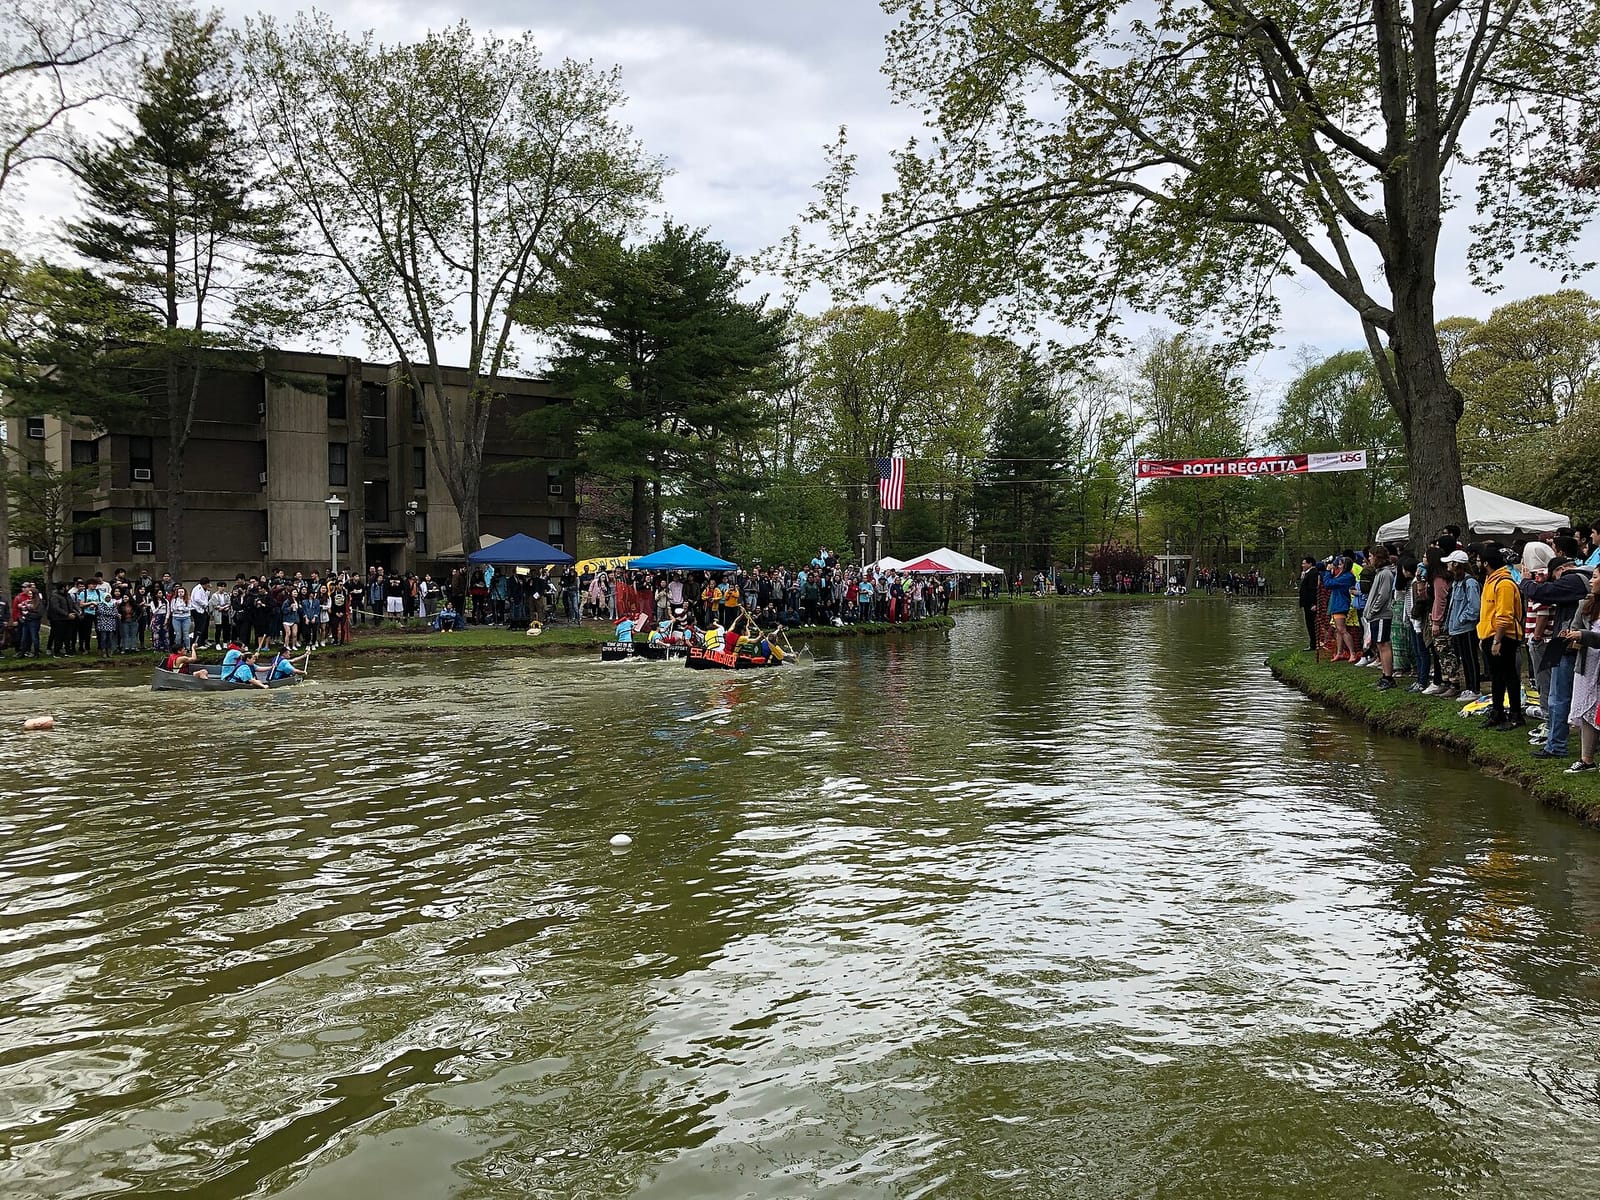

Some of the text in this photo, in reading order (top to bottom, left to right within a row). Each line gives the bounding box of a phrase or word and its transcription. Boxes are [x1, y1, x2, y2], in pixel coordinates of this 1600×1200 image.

[1340, 453, 1361, 462] USG
[1183, 463, 1224, 474] ROTH
[1228, 460, 1297, 473] REGATTA
[690, 647, 703, 658] SS
